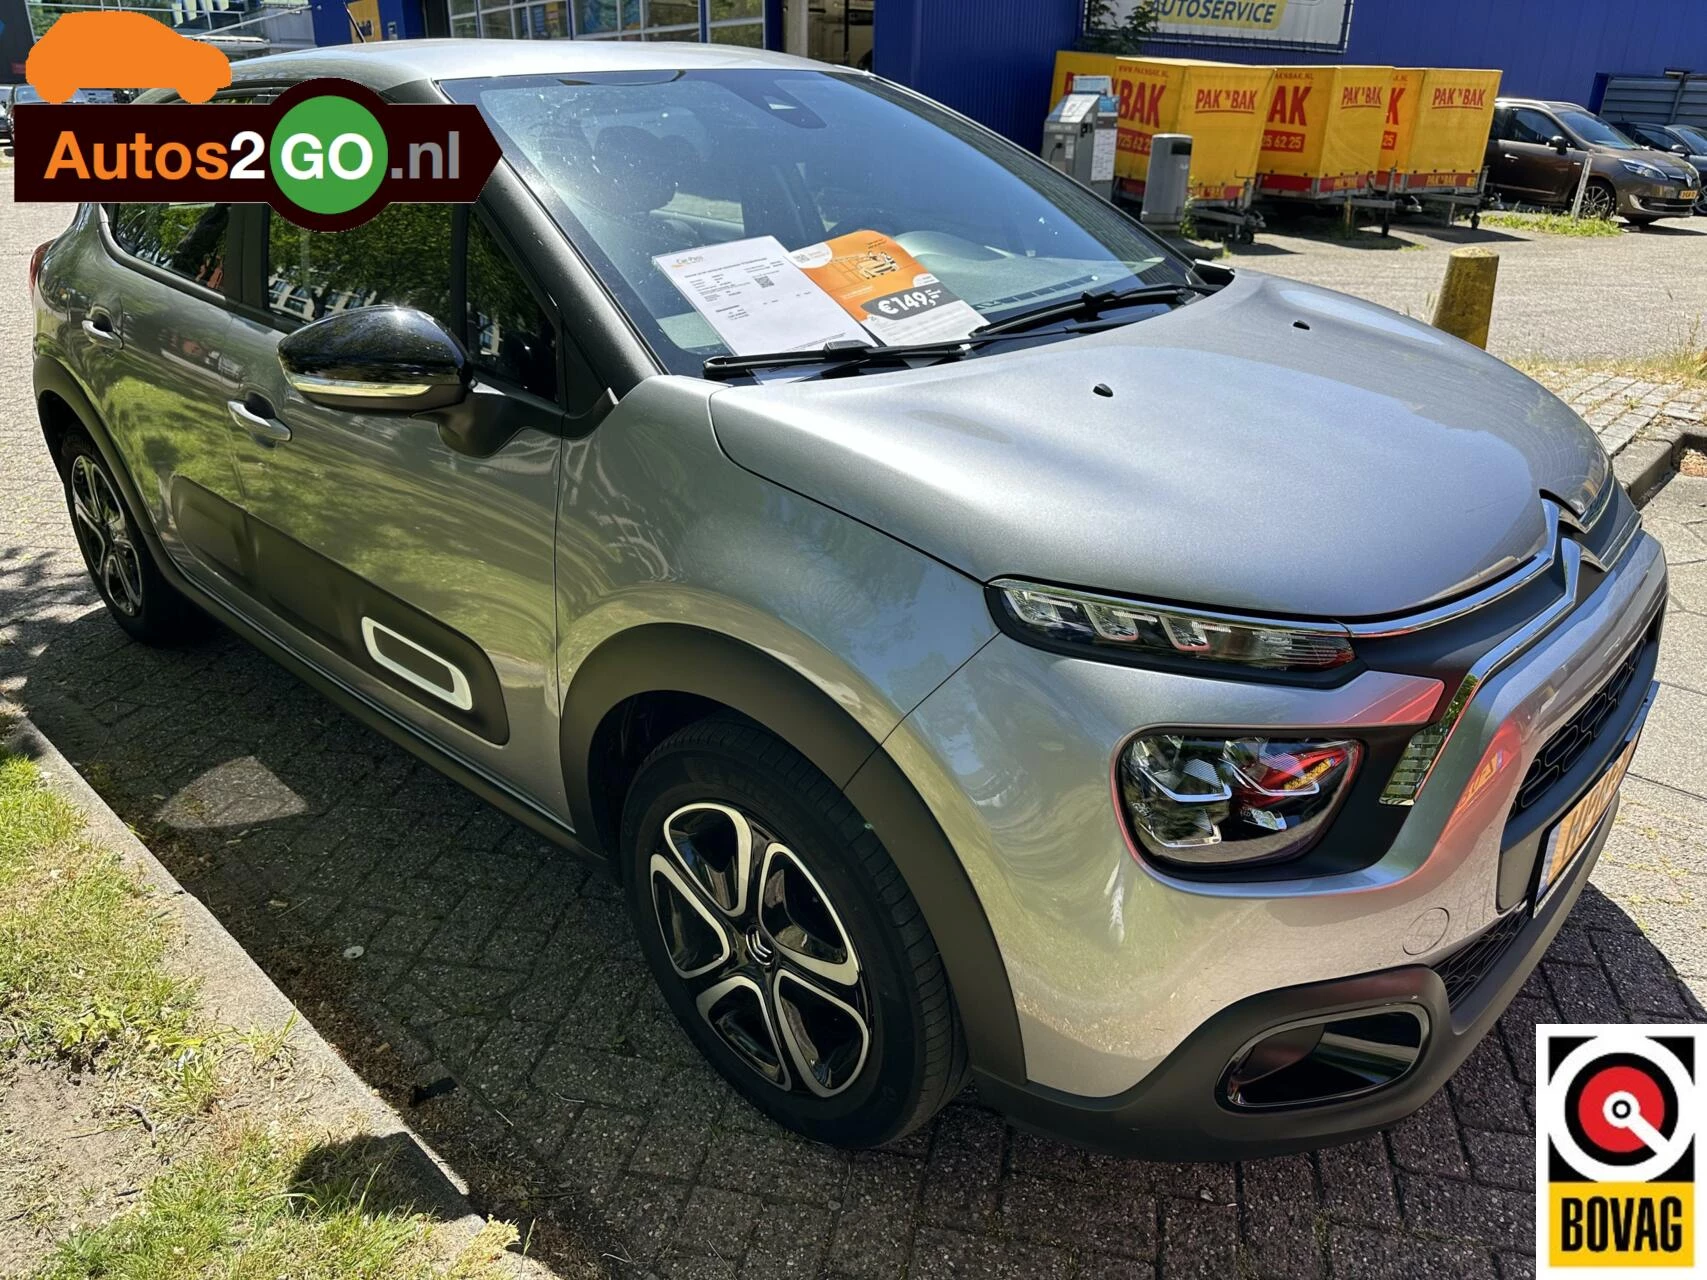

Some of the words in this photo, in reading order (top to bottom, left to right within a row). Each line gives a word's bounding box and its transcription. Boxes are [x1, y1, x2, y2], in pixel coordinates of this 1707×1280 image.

[1119, 79, 1167, 128] BAK
[1195, 88, 1222, 109] PAK
[1231, 89, 1258, 111] BAK
[1267, 85, 1312, 127] AK
[1341, 86, 1360, 106] PAK
[1365, 86, 1383, 106] BAK
[1432, 87, 1456, 107] PAK
[1462, 88, 1486, 107] BAK
[1262, 134, 1273, 148] 25
[1273, 134, 1287, 149] 62
[1288, 135, 1302, 150] 25
